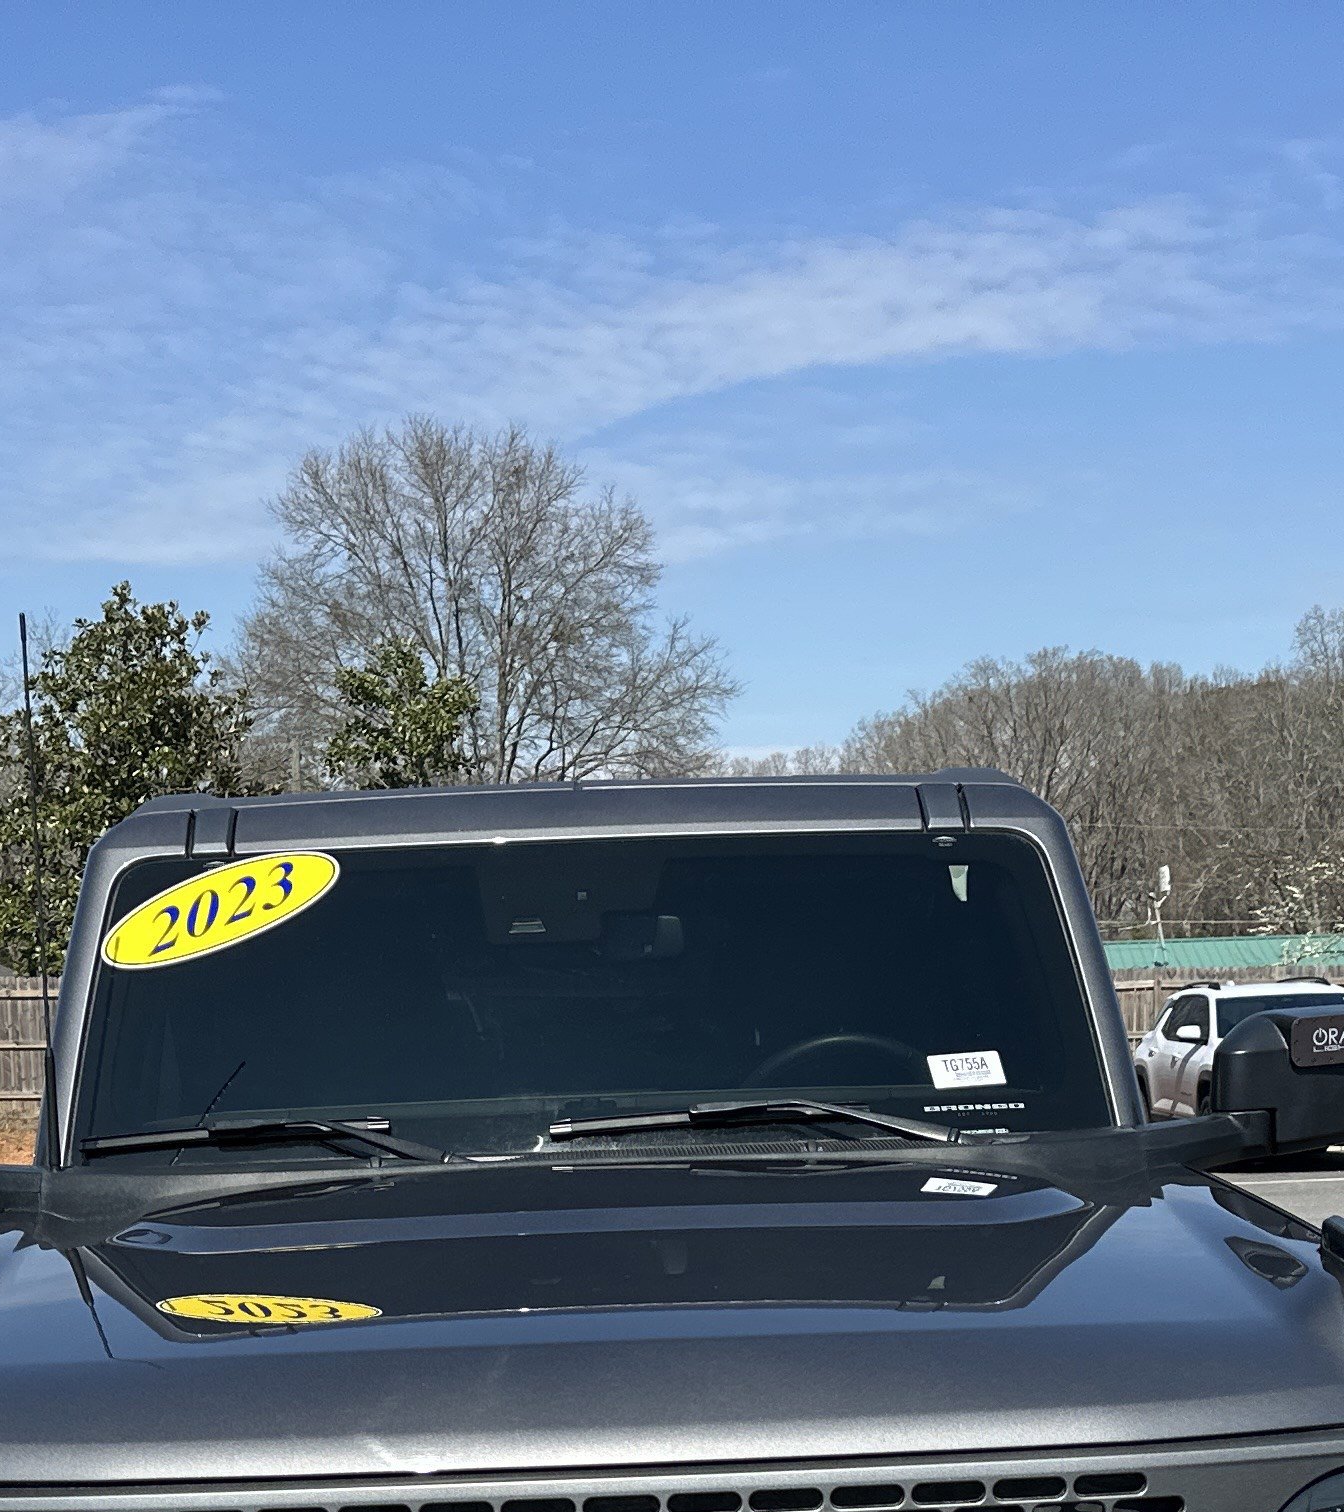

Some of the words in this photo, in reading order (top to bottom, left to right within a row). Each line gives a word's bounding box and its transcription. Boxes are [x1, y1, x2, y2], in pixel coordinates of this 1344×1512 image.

[148, 861, 294, 957] 2023
[941, 1056, 989, 1072] TG755A
[923, 1102, 1026, 1113] BRONCO
